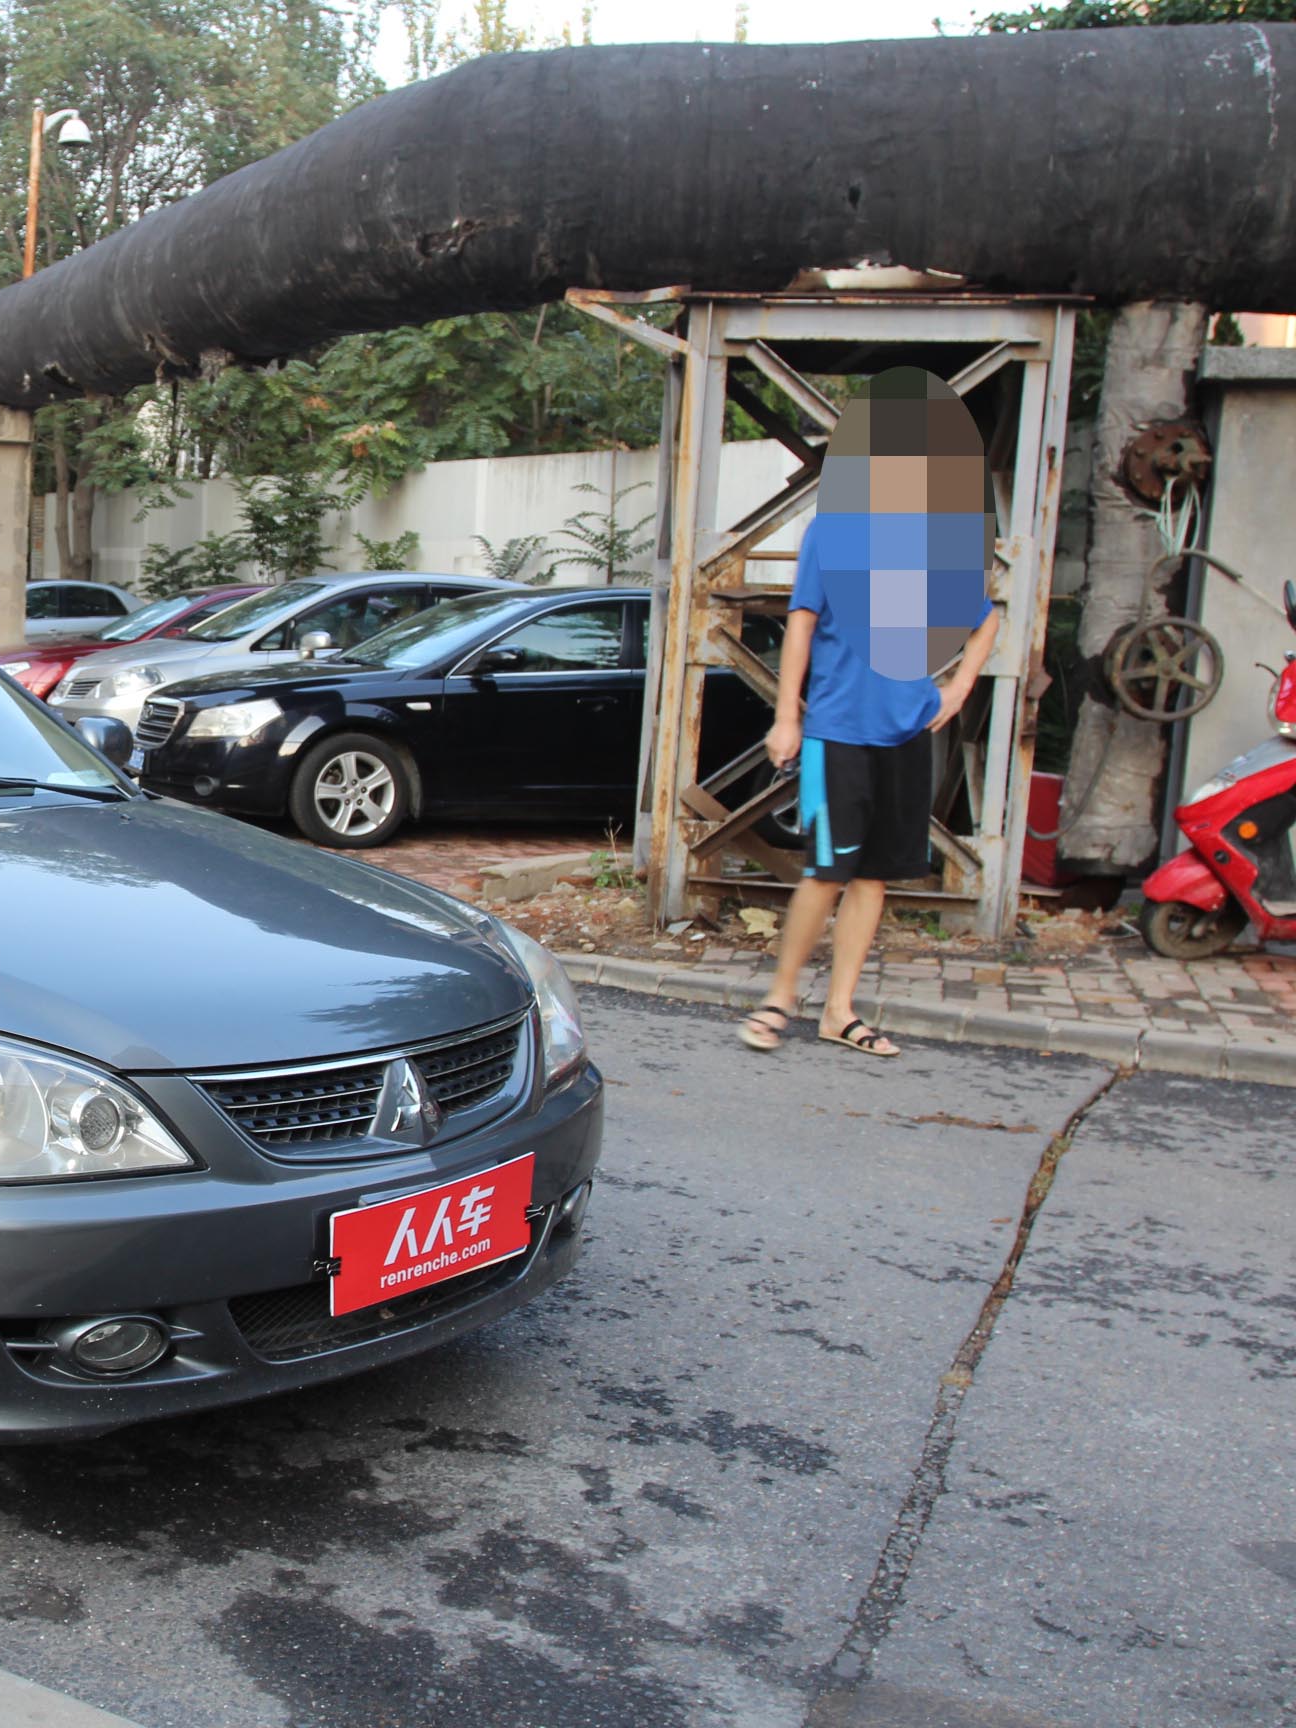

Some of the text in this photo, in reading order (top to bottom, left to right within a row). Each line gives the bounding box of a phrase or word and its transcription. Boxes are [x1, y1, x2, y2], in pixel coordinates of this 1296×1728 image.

[384, 1186, 495, 1266] 人人车
[380, 1238, 491, 1288] renrenche.com
